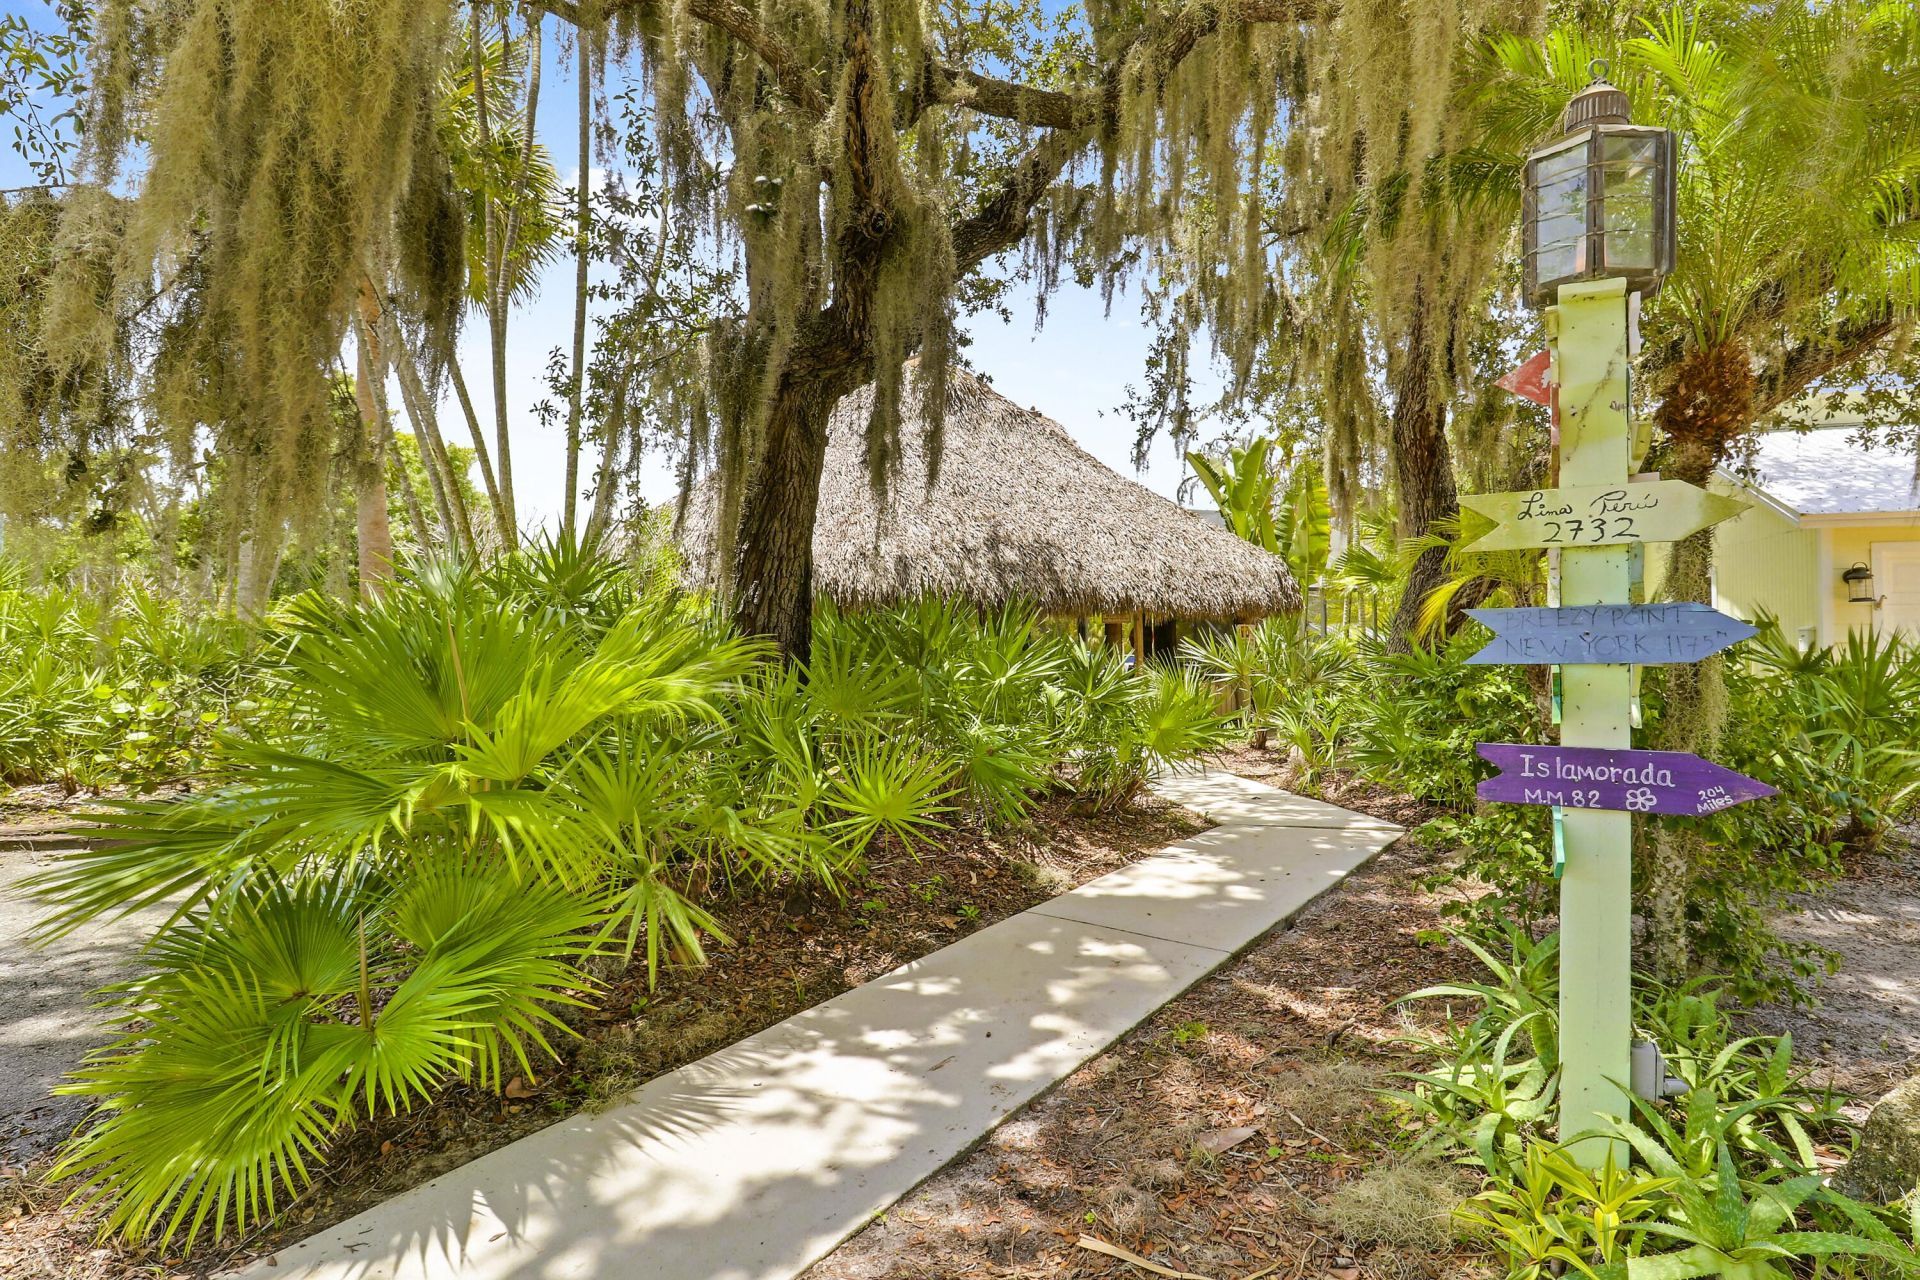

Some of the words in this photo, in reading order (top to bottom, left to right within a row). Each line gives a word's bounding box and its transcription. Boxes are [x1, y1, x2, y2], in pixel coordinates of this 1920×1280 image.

[1517, 492, 1573, 520] Lima
[1542, 517, 1640, 542] 2732
[1504, 607, 1598, 630] BREEZY
[1605, 605, 1682, 627] POINT
[1505, 638, 1567, 657] NEW
[1579, 633, 1650, 656] YORK
[1519, 753, 1676, 788] Islamorada
[1696, 795, 1734, 814] Miles
[1698, 785, 1725, 801] 204
